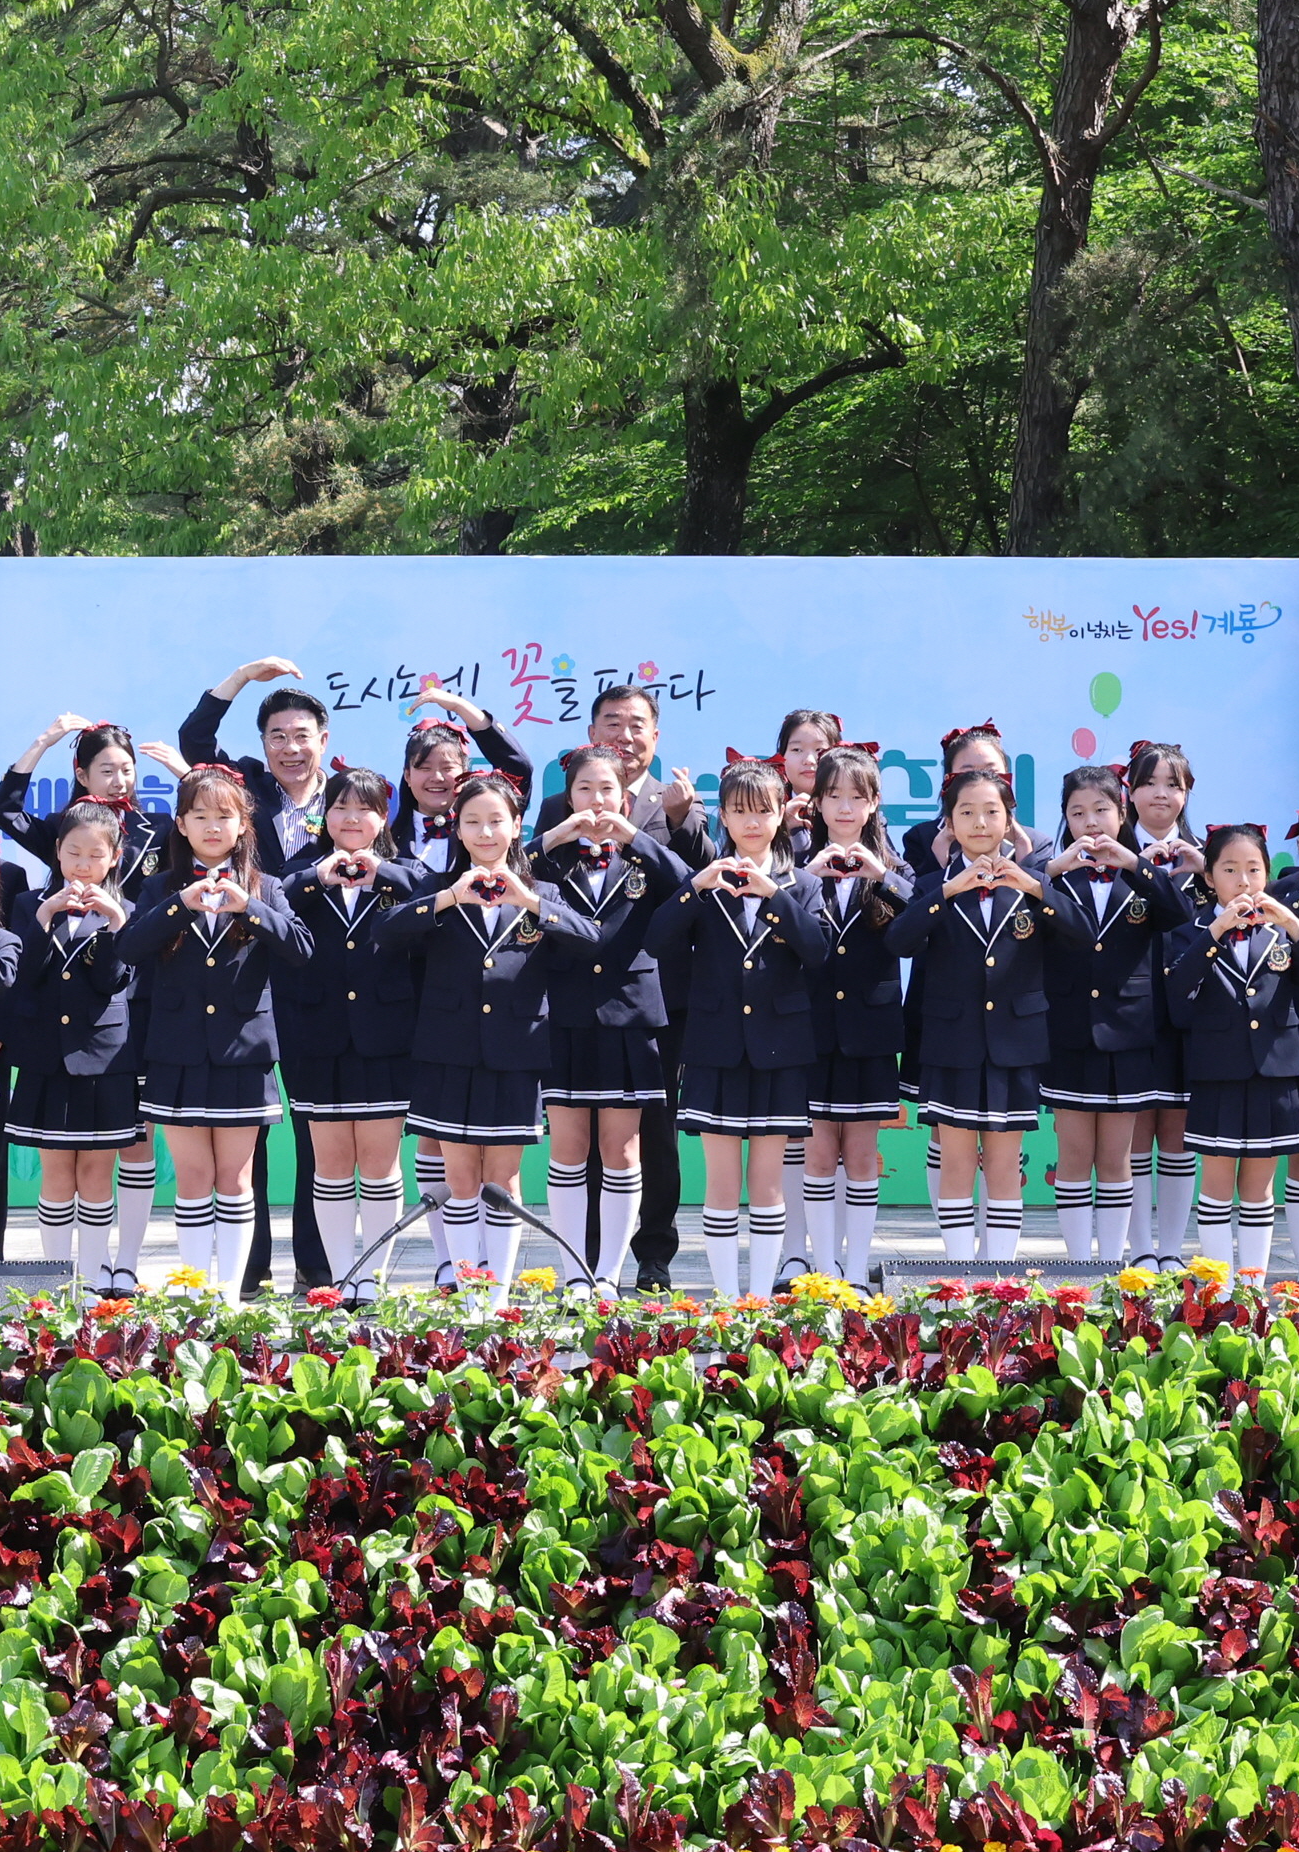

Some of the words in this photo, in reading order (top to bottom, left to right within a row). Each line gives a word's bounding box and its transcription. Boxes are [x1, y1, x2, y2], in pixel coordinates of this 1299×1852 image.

[1132, 604, 1198, 641] Yes!
[1202, 602, 1259, 644] 계룡
[502, 642, 581, 727] 꽃을
